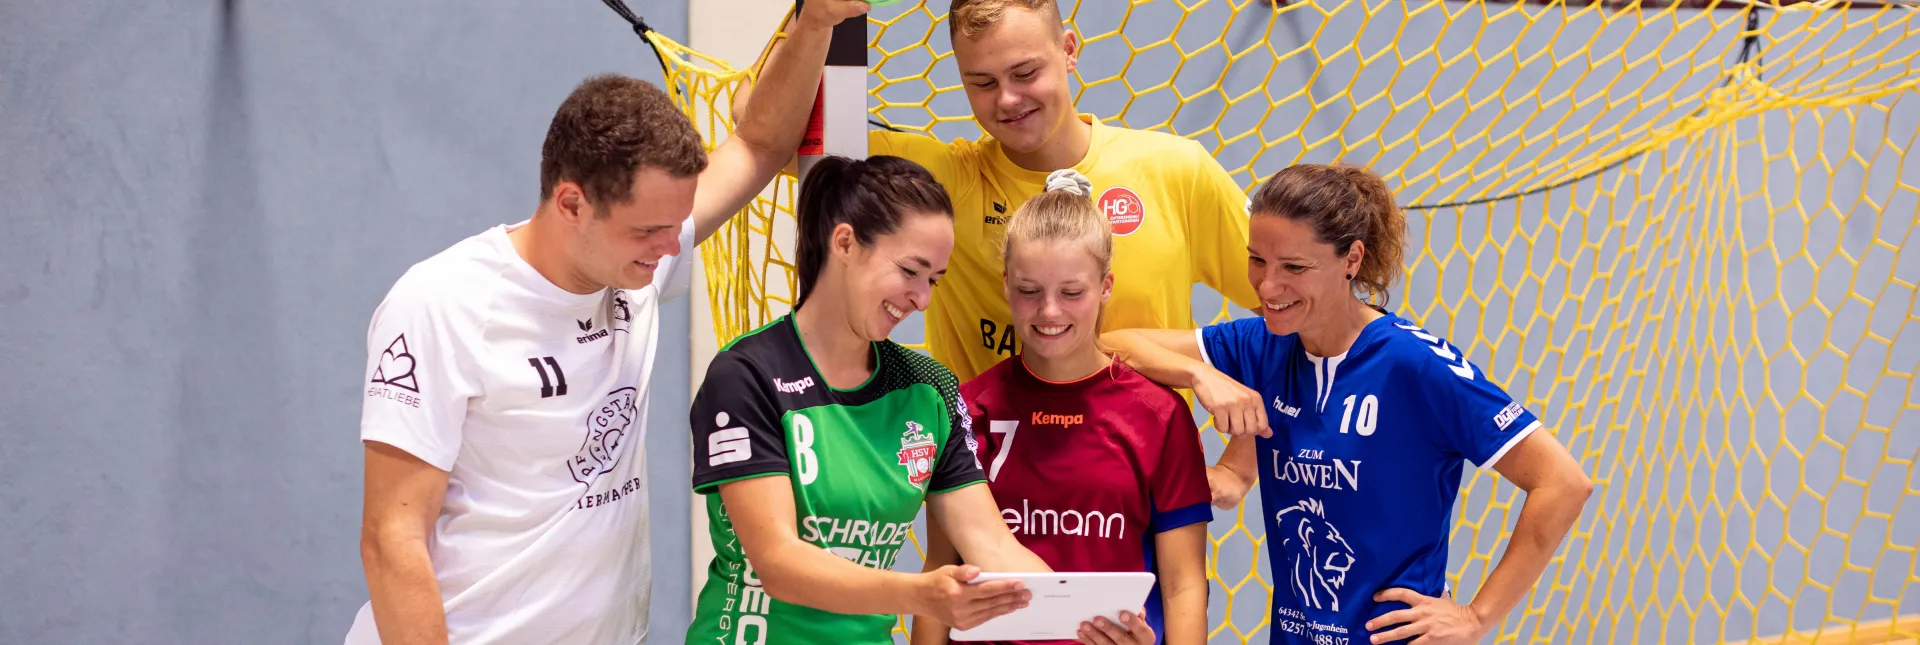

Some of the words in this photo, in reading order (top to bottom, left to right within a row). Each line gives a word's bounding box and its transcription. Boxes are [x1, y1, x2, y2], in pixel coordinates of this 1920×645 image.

[576, 328, 609, 345] erima
[528, 356, 568, 398] 11
[1031, 410, 1084, 429] Kempa
[1339, 394, 1379, 437] 10
[910, 447, 930, 458] HSV
[989, 419, 1020, 483] 7
[1297, 447, 1325, 460] ZUM
[1271, 448, 1362, 492] LÖWEN
[1278, 606, 1300, 620] 64342
